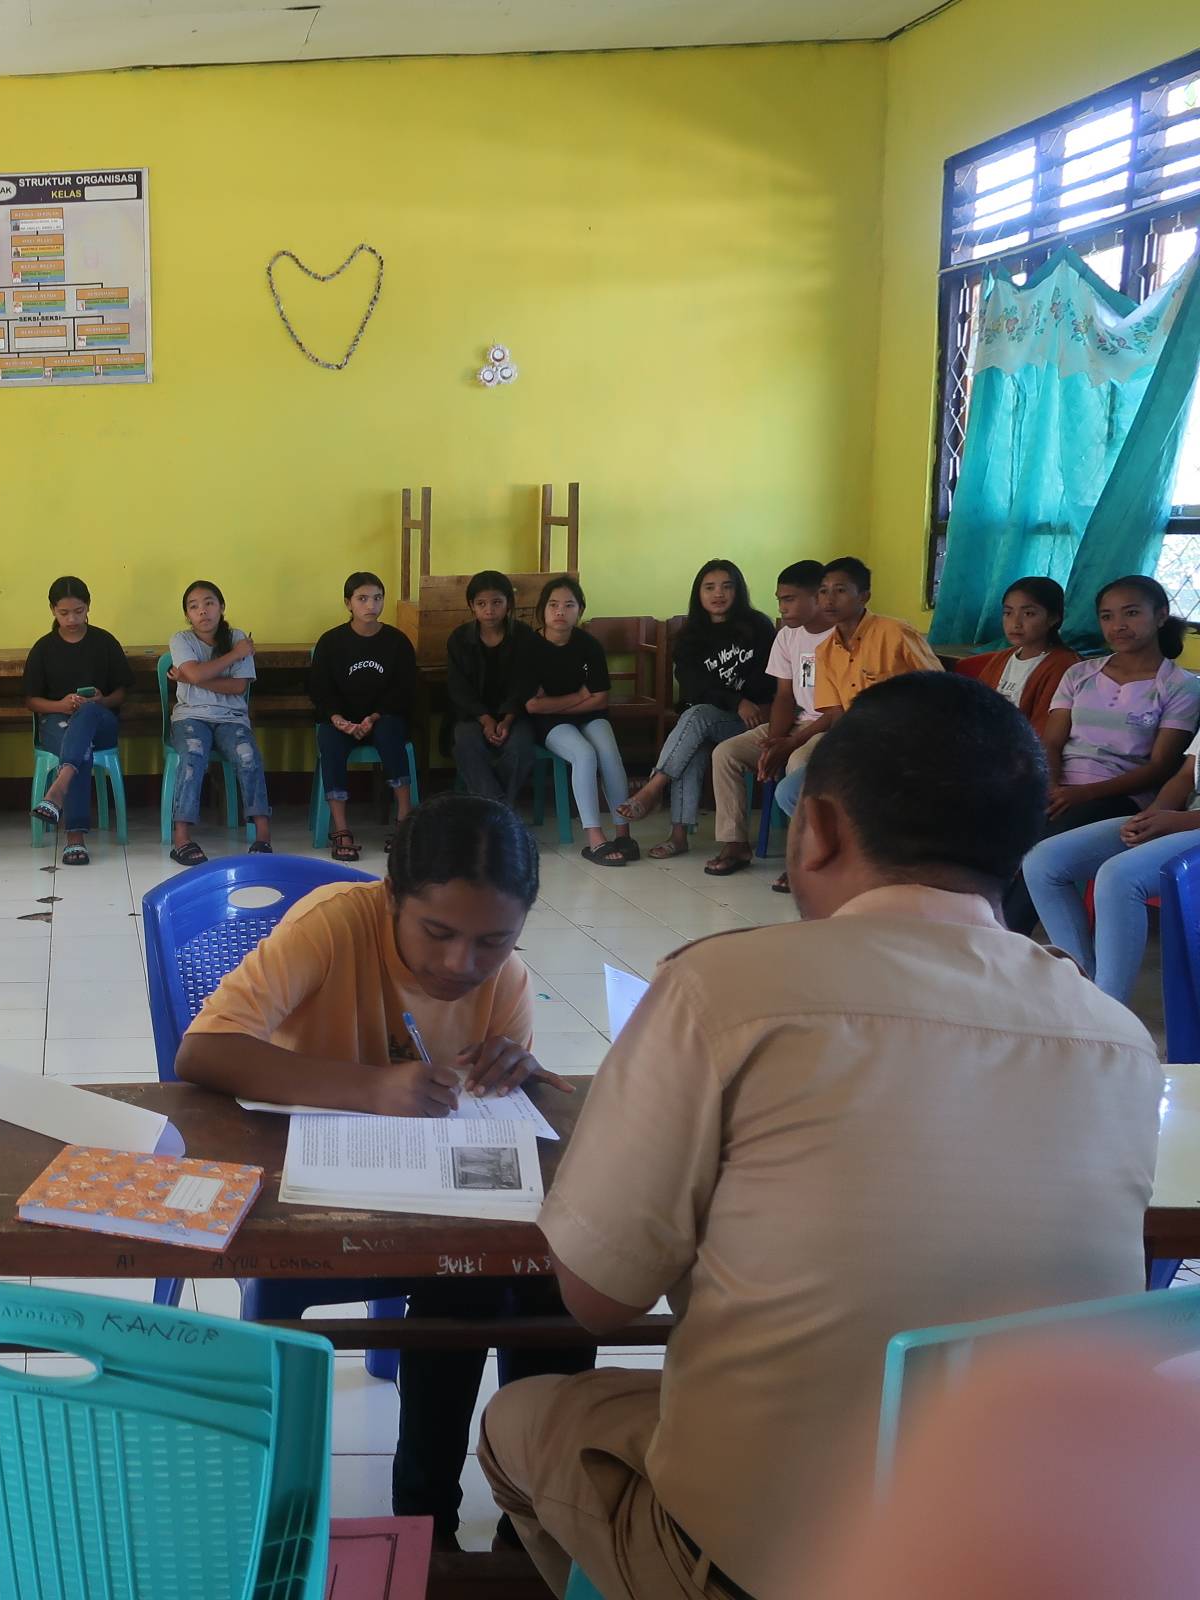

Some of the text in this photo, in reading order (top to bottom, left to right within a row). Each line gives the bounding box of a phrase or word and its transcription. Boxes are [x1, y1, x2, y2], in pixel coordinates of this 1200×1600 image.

[18, 174, 137, 188] STRUKTUR ORGANISASI
[51, 190, 82, 199] KELAS
